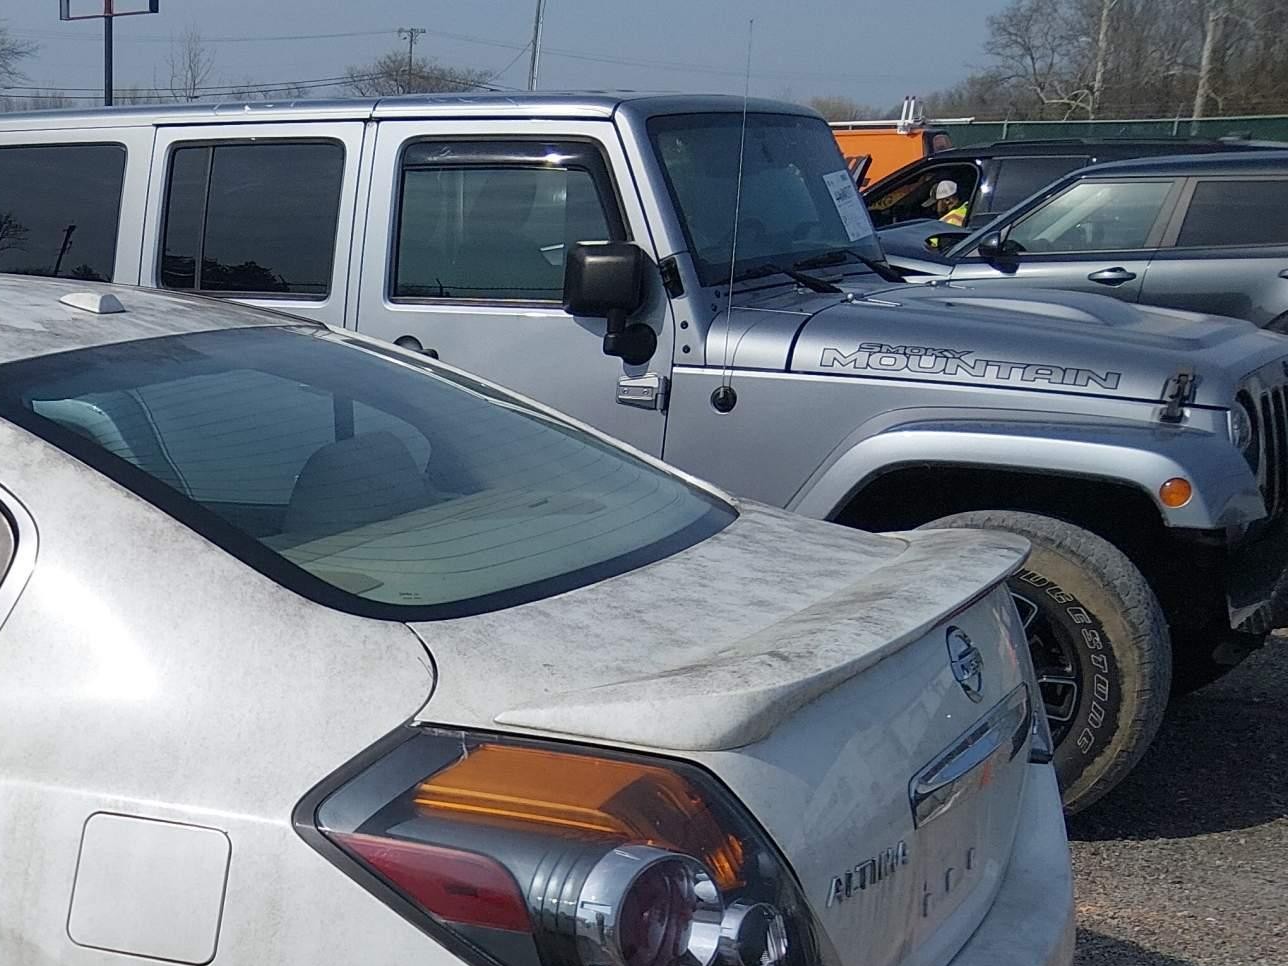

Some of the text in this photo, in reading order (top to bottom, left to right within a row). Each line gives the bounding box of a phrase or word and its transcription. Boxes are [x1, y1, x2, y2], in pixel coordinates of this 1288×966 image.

[820, 347, 1122, 390] MOUNTAIN
[859, 342, 975, 359] SMOKY
[1013, 568, 1109, 755] DGESTONE
[826, 840, 908, 908] ALTIMA
